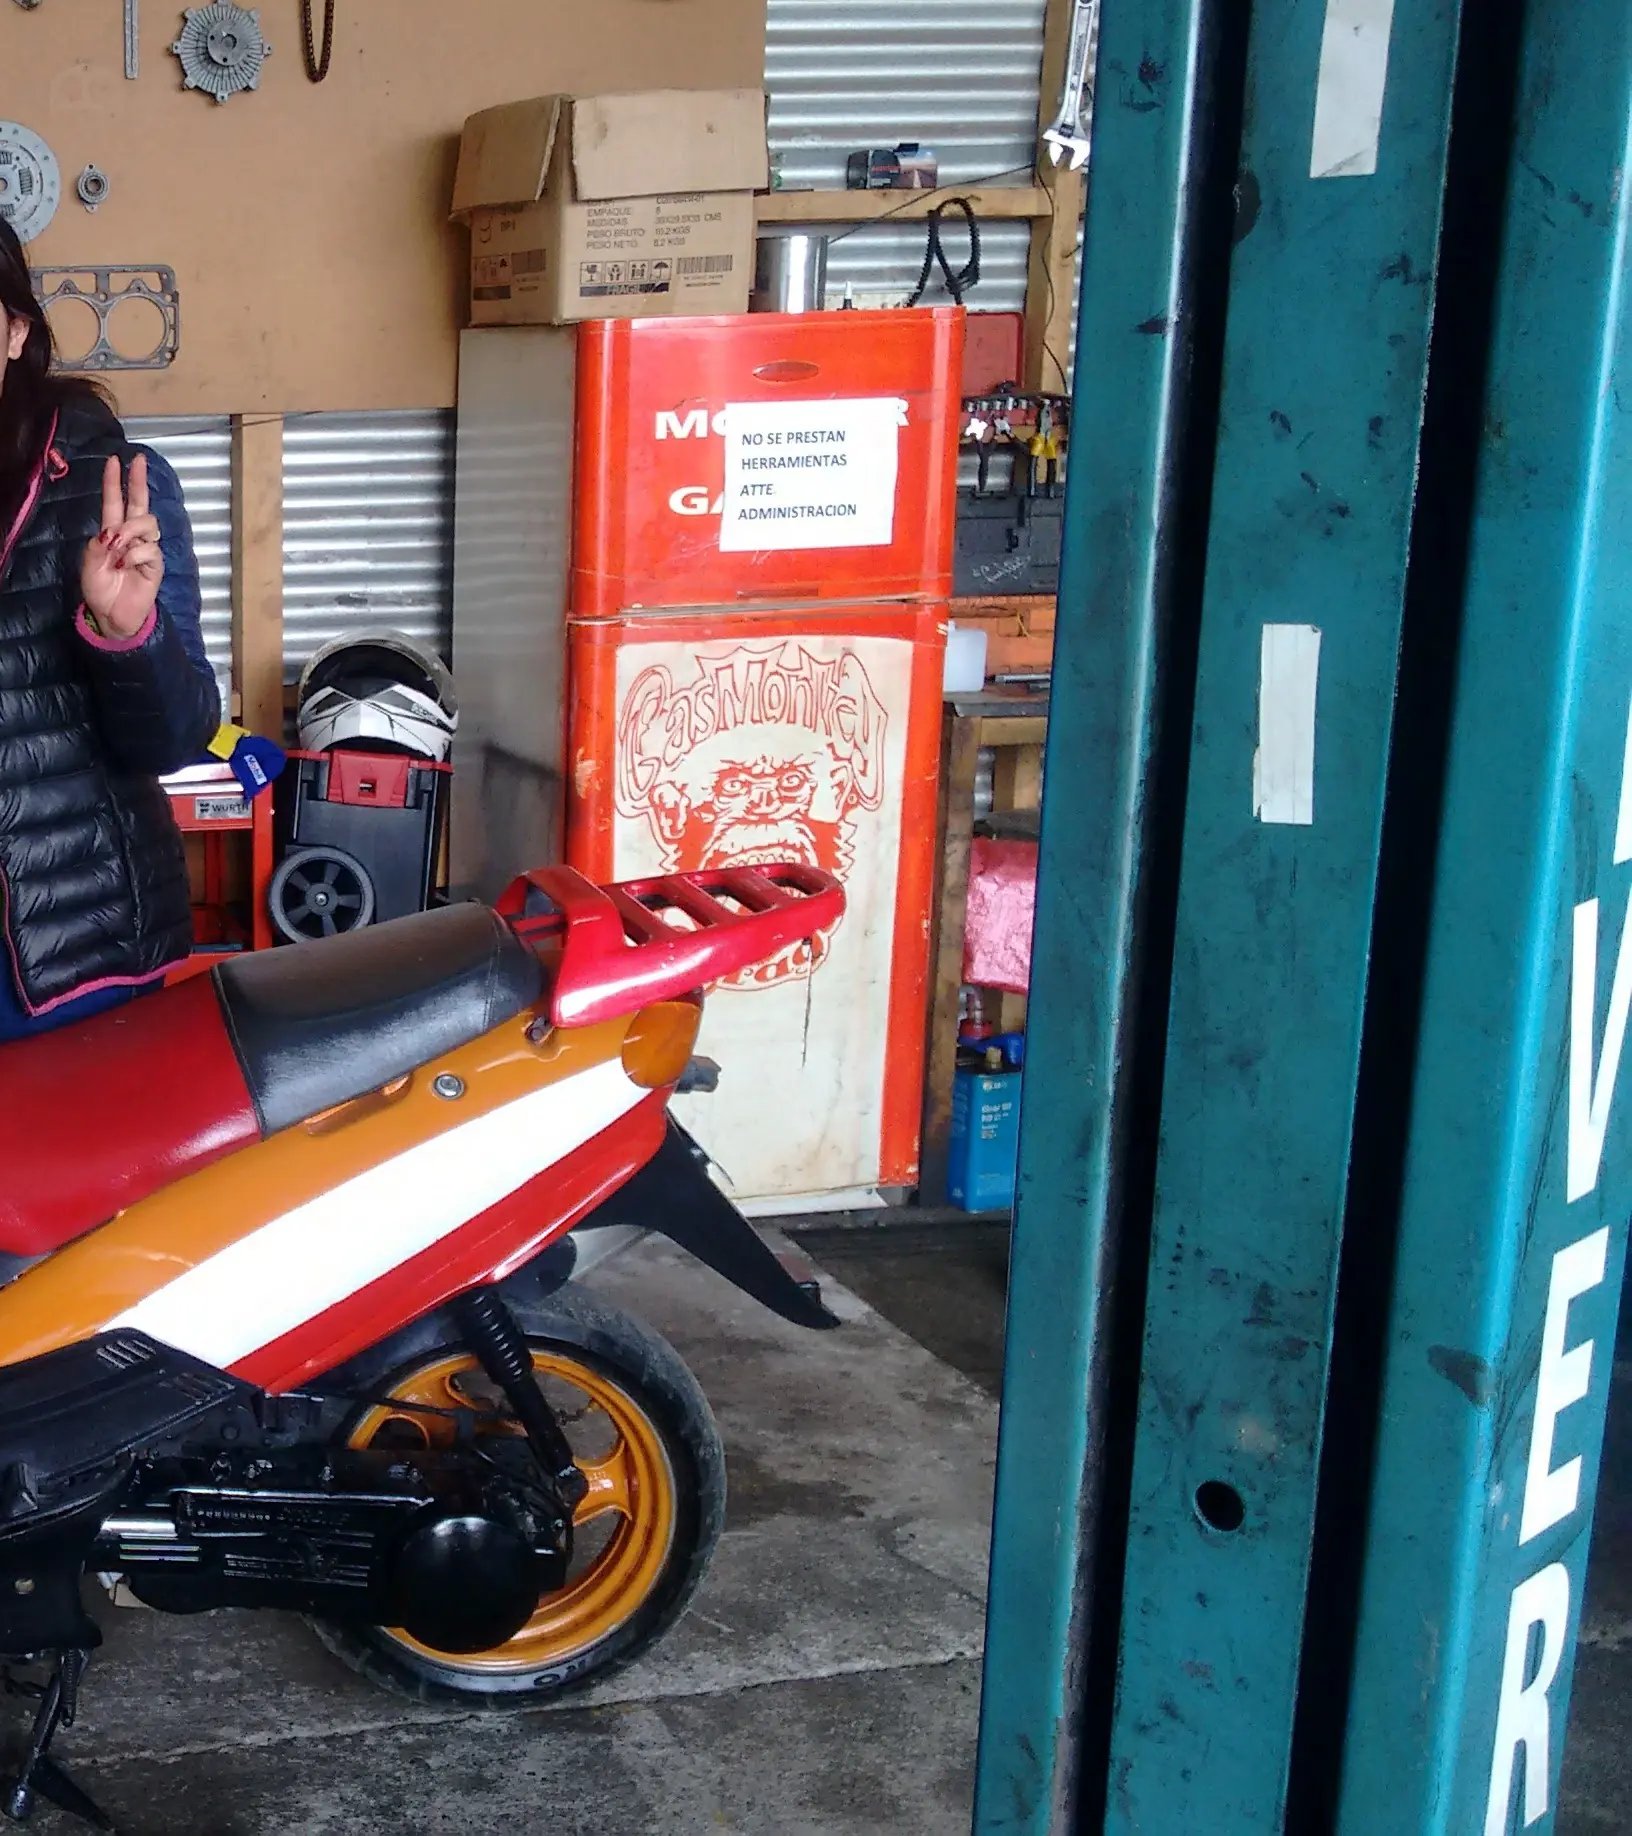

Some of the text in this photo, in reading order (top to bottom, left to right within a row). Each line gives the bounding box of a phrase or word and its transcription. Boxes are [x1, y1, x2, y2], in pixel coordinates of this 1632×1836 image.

[741, 430, 846, 446] NO SE PRESTAN
[741, 454, 848, 471] HERRAMIENTAS
[738, 503, 857, 520] ADMINISTRACION
[1483, 690, 1632, 1836] VER
